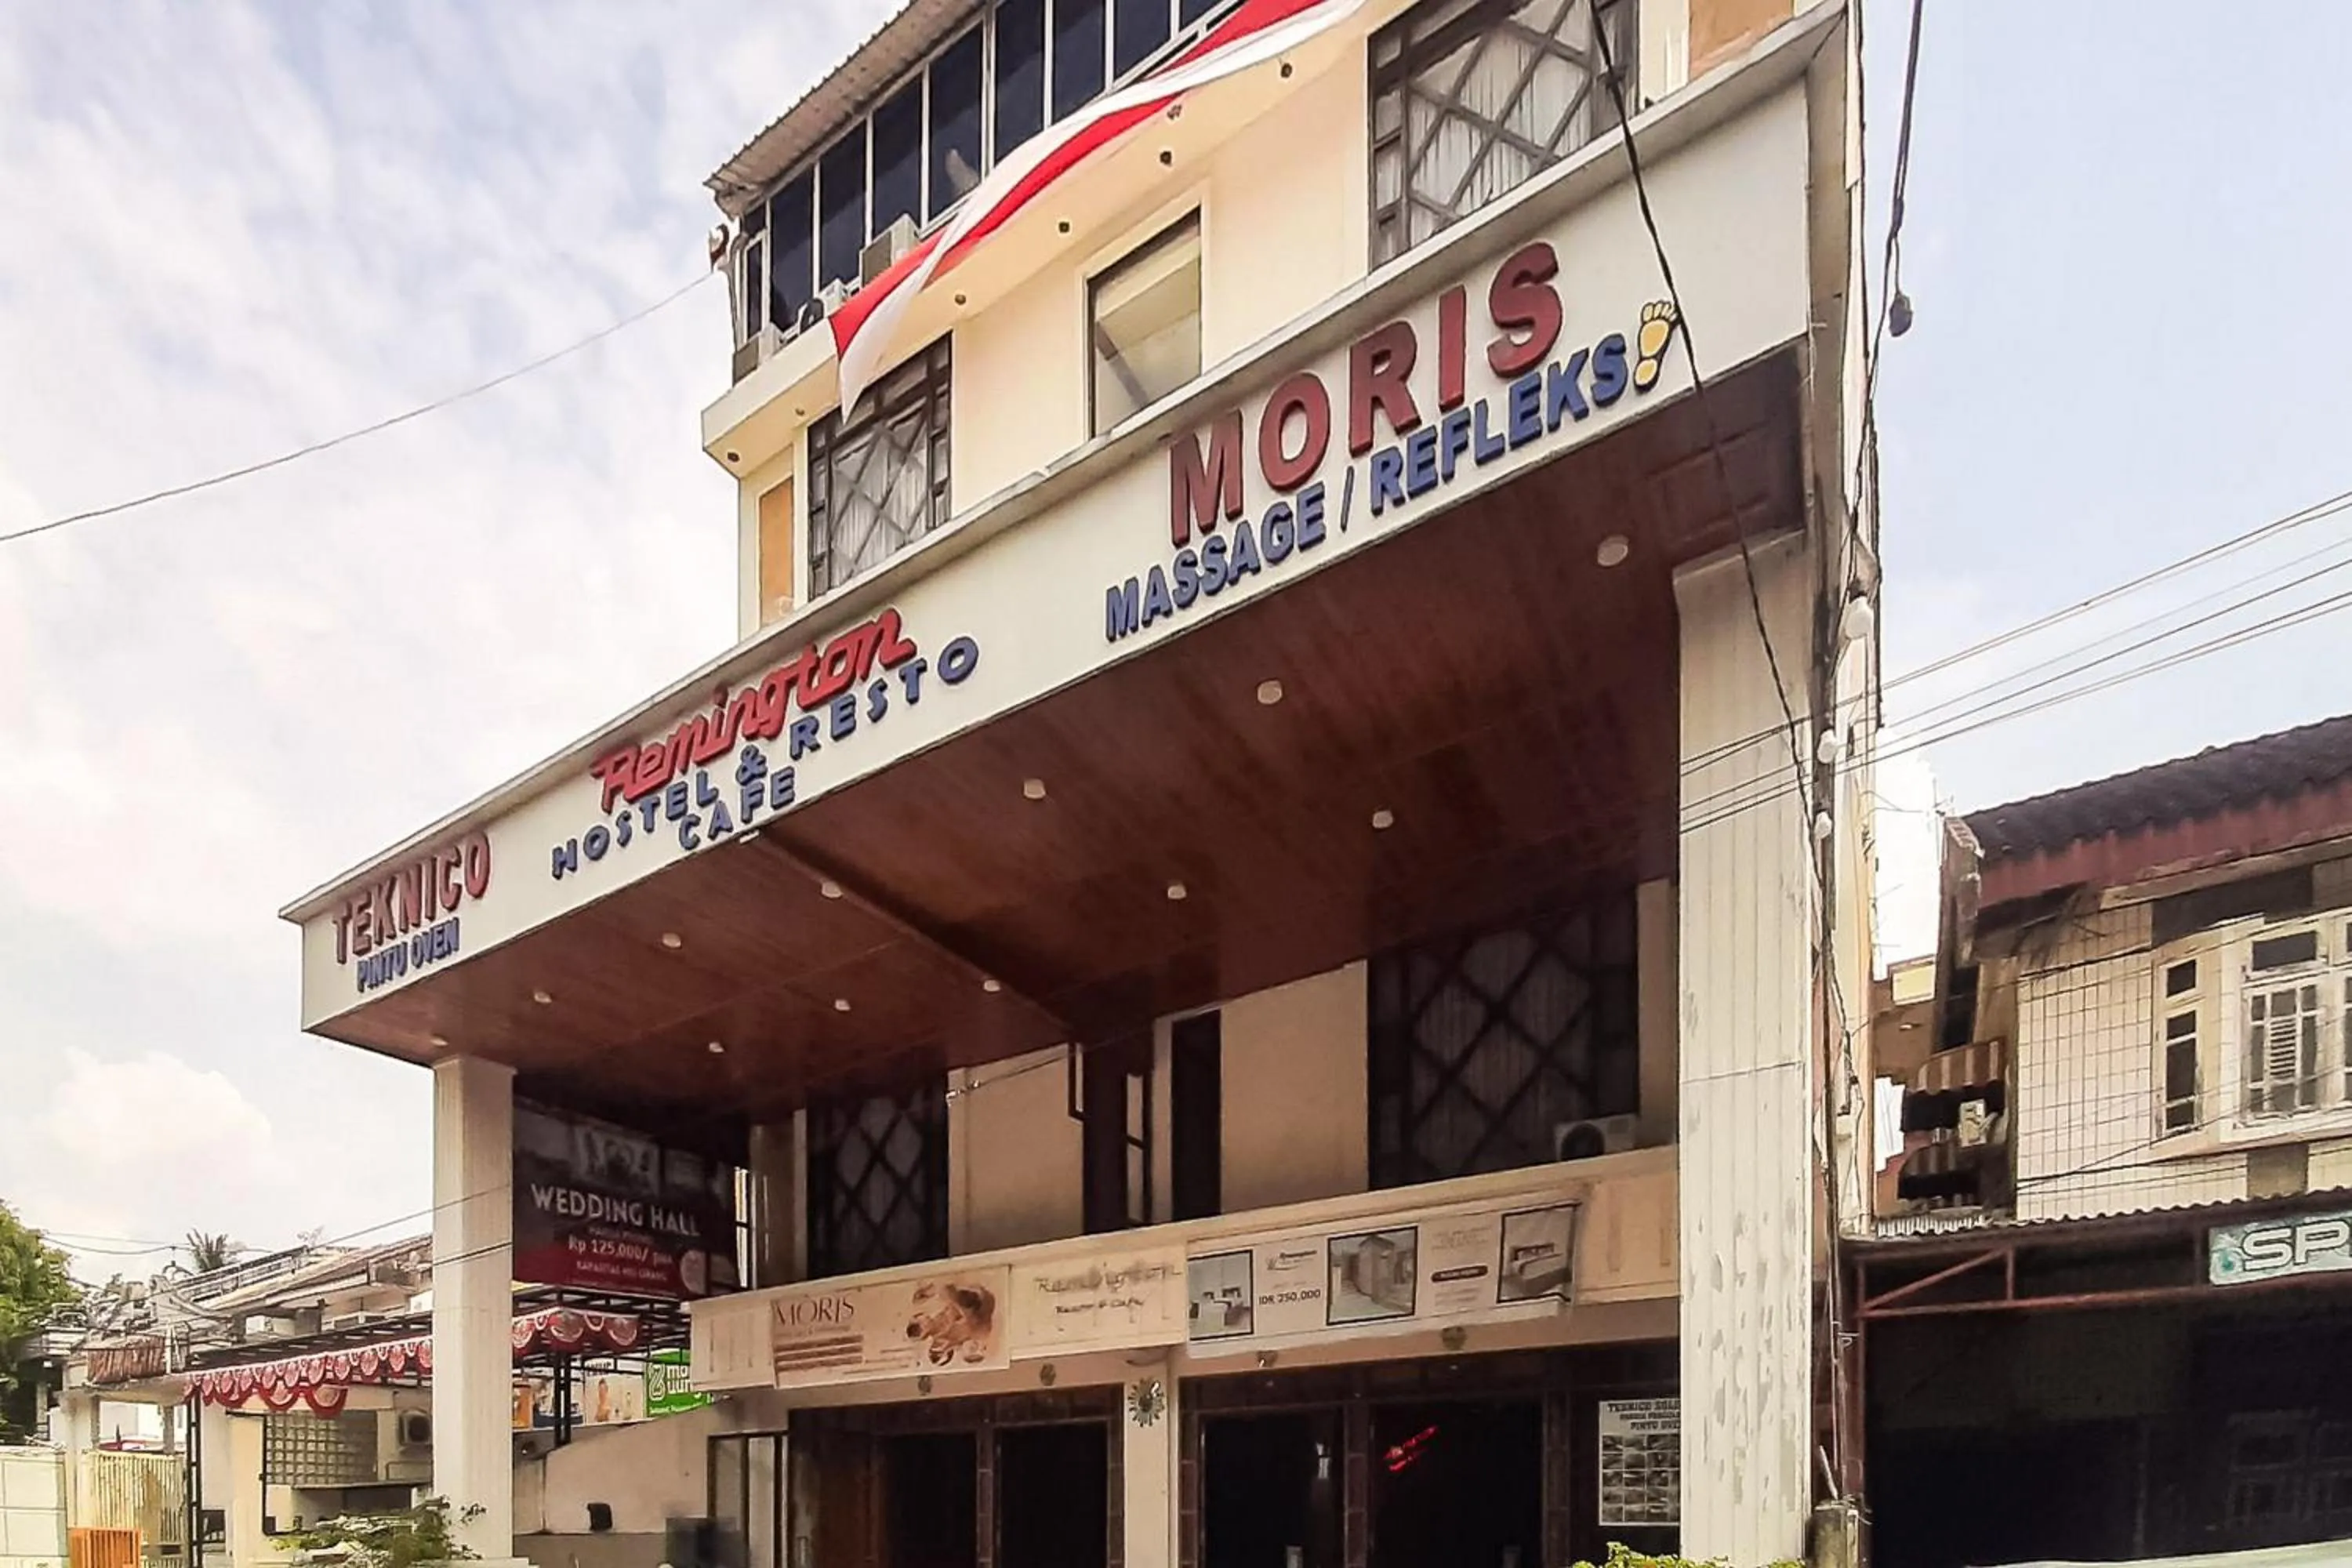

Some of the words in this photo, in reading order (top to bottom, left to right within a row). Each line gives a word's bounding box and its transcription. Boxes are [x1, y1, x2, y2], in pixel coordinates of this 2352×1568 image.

[1167, 241, 1563, 549] MORIS
[1105, 483, 1326, 643] MASSAGE
[1370, 333, 1628, 515] REFLEKS
[551, 769, 719, 879] HOSTEL
[735, 744, 767, 784] &
[790, 635, 979, 761] RESTO
[590, 607, 916, 814] Remington
[678, 765, 796, 850] CAFE
[332, 829, 492, 965] TEKNICO
[357, 940, 408, 993] PINTU
[410, 916, 461, 969] OVEN
[530, 1182, 644, 1226] WEDDING
[650, 1205, 701, 1236] HALL
[568, 1234, 586, 1254] Rp
[775, 1297, 855, 1327] MORIS
